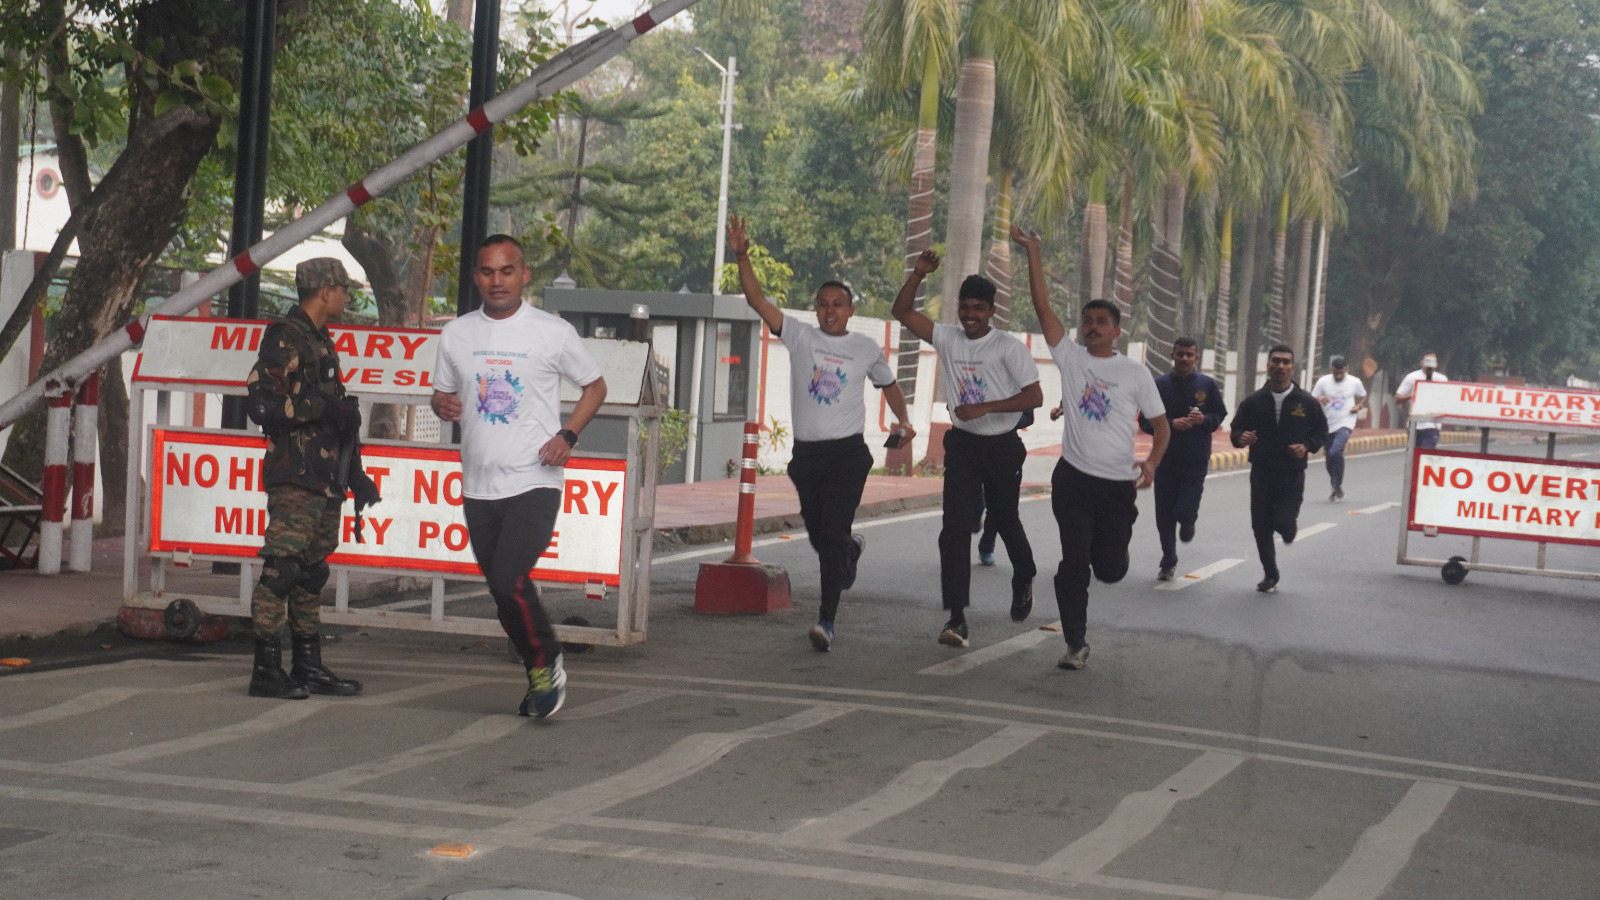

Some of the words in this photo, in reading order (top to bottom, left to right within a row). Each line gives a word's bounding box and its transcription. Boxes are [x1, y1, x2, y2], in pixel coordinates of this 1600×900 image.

[1500, 408, 1581, 423] DRIVE
[166, 452, 220, 488] NO
[413, 469, 463, 507] NO
[1422, 465, 1473, 490] NO
[1457, 500, 1581, 527] MILITARY
